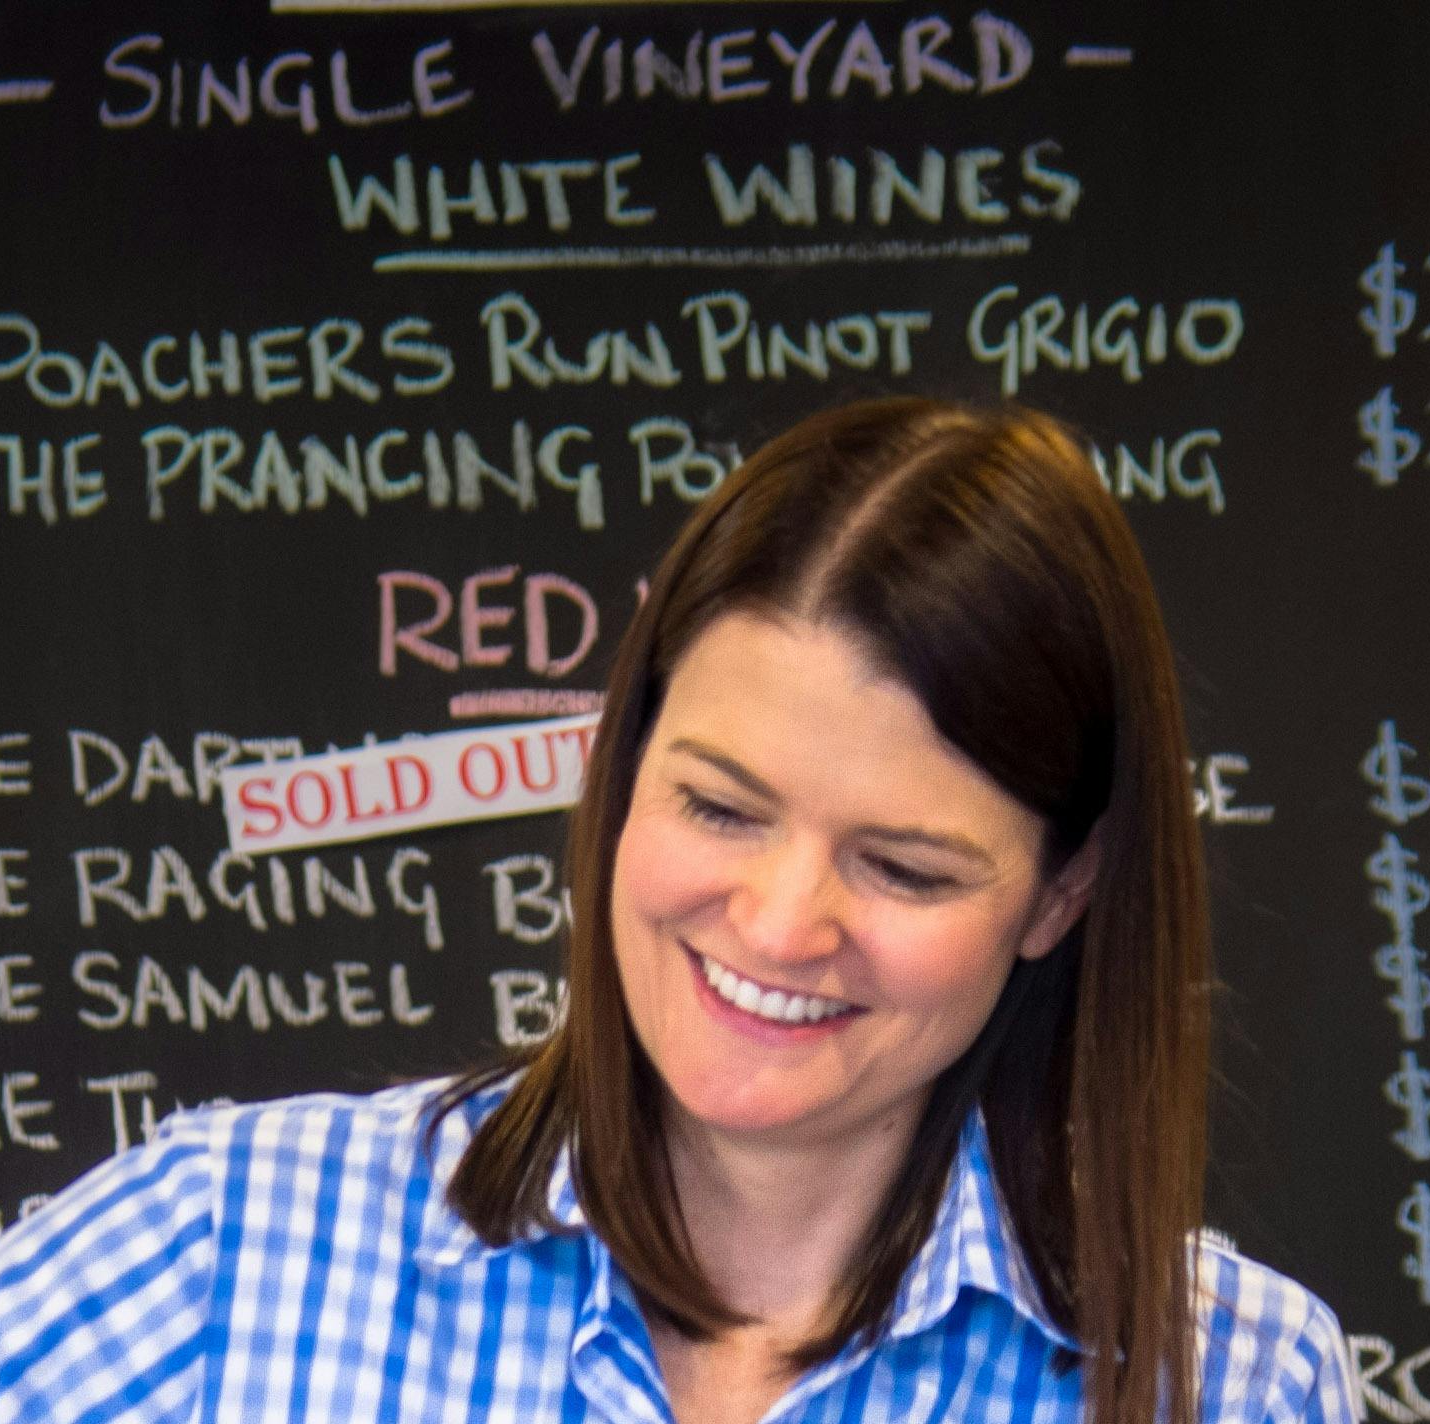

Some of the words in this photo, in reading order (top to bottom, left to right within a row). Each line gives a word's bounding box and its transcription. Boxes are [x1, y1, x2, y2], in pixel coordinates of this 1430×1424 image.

[99, 33, 474, 133] SINGLE
[533, 14, 1034, 108] VINEYARD
[328, 150, 657, 239] WHITE
[704, 140, 1082, 225] WINES
[680, 290, 932, 386] PINOT
[968, 287, 1245, 396] GRIGIO
[141, 424, 605, 529] PRANCING
[377, 564, 599, 678] RED
[237, 755, 433, 839] SOLD
[458, 726, 595, 800] OUT
[73, 846, 444, 950] RAGING
[73, 950, 433, 1033] SAMUEL
